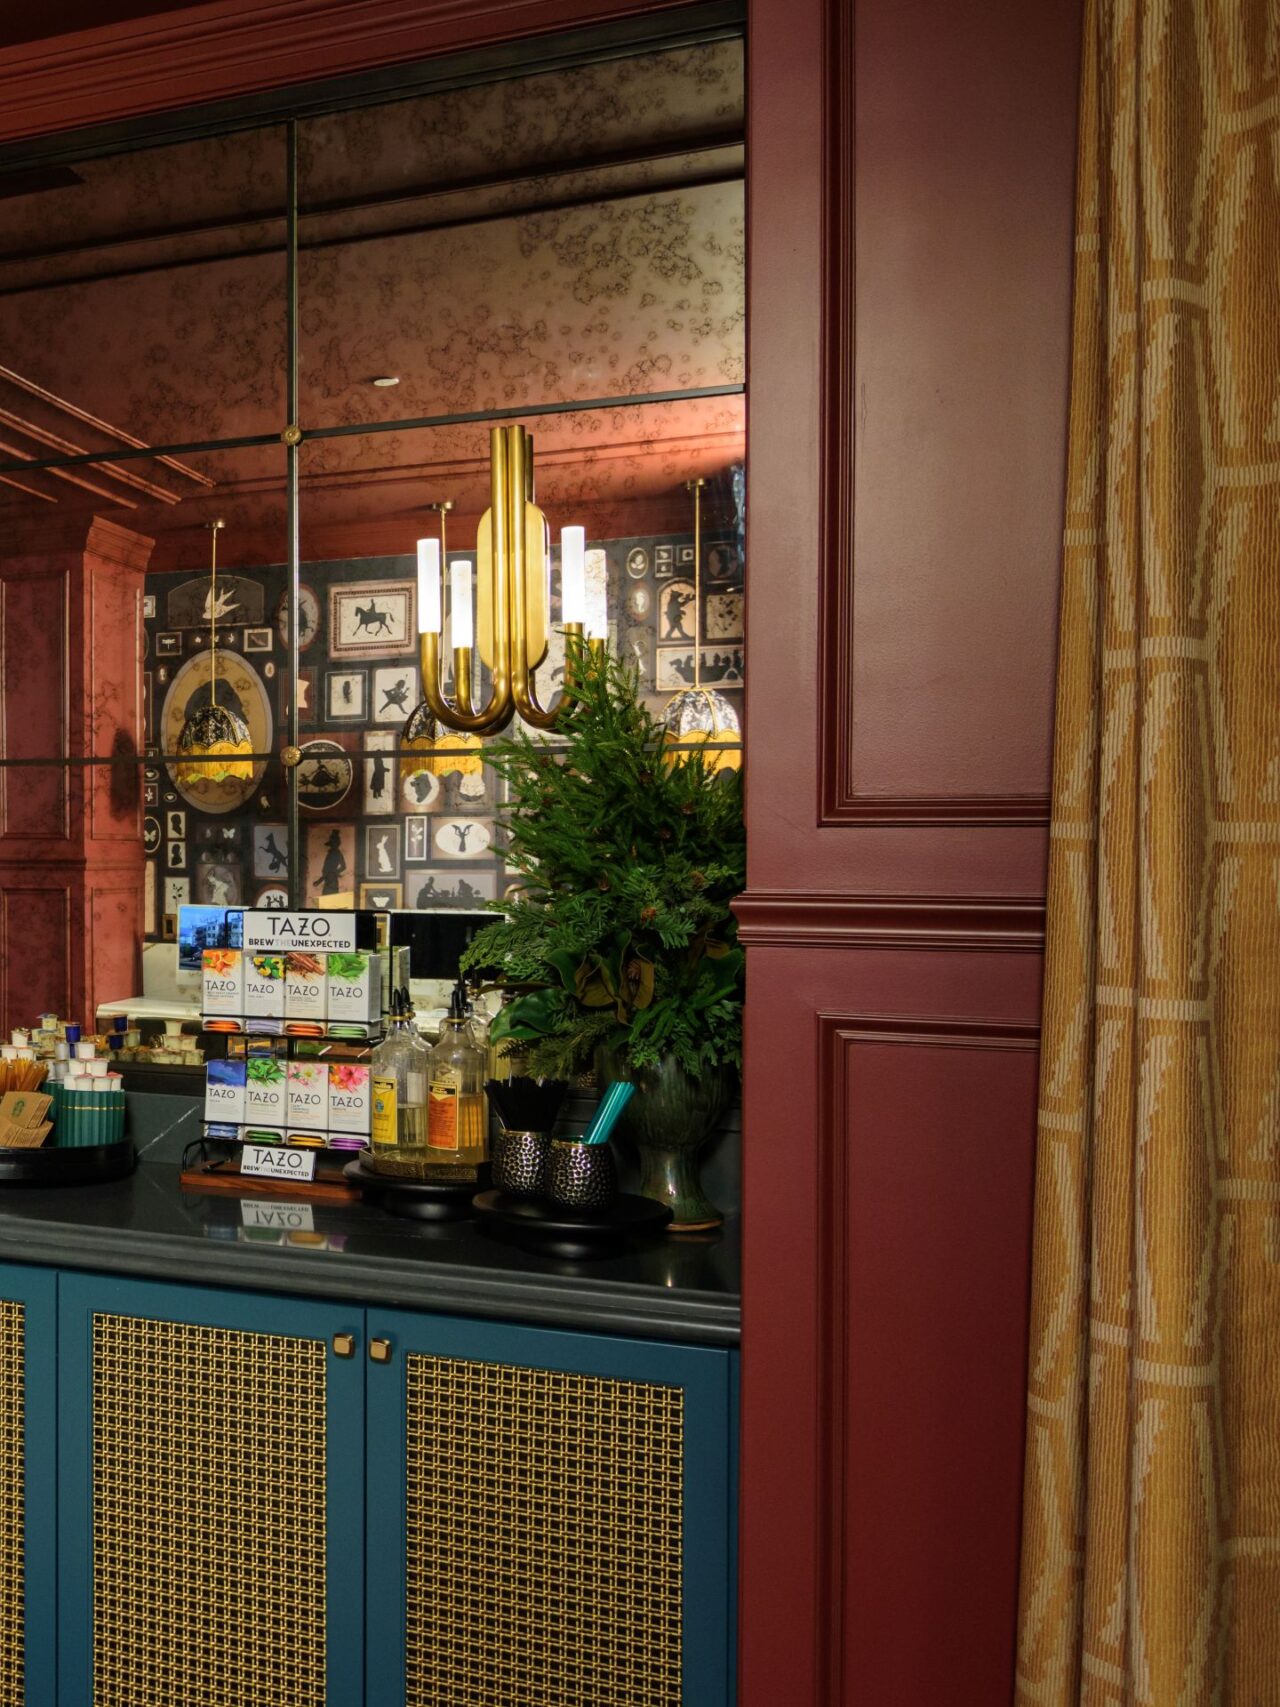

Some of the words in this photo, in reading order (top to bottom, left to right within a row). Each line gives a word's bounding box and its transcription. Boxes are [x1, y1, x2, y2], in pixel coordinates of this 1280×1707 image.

[267, 917, 330, 937] TAZO
[248, 938, 274, 946] BREW
[291, 940, 351, 948] UNEXPECTED
[205, 980, 236, 991] TAZO
[247, 984, 275, 994] TAZO
[287, 985, 320, 997] TAZO
[330, 986, 363, 998] TAZO
[208, 1088, 236, 1099] TAZO
[248, 1091, 280, 1103] TAZO
[289, 1093, 321, 1105] TAZO
[330, 1096, 364, 1108] TAZO
[253, 1149, 302, 1168] TAZO
[271, 1168, 309, 1177] UNEXPECTED
